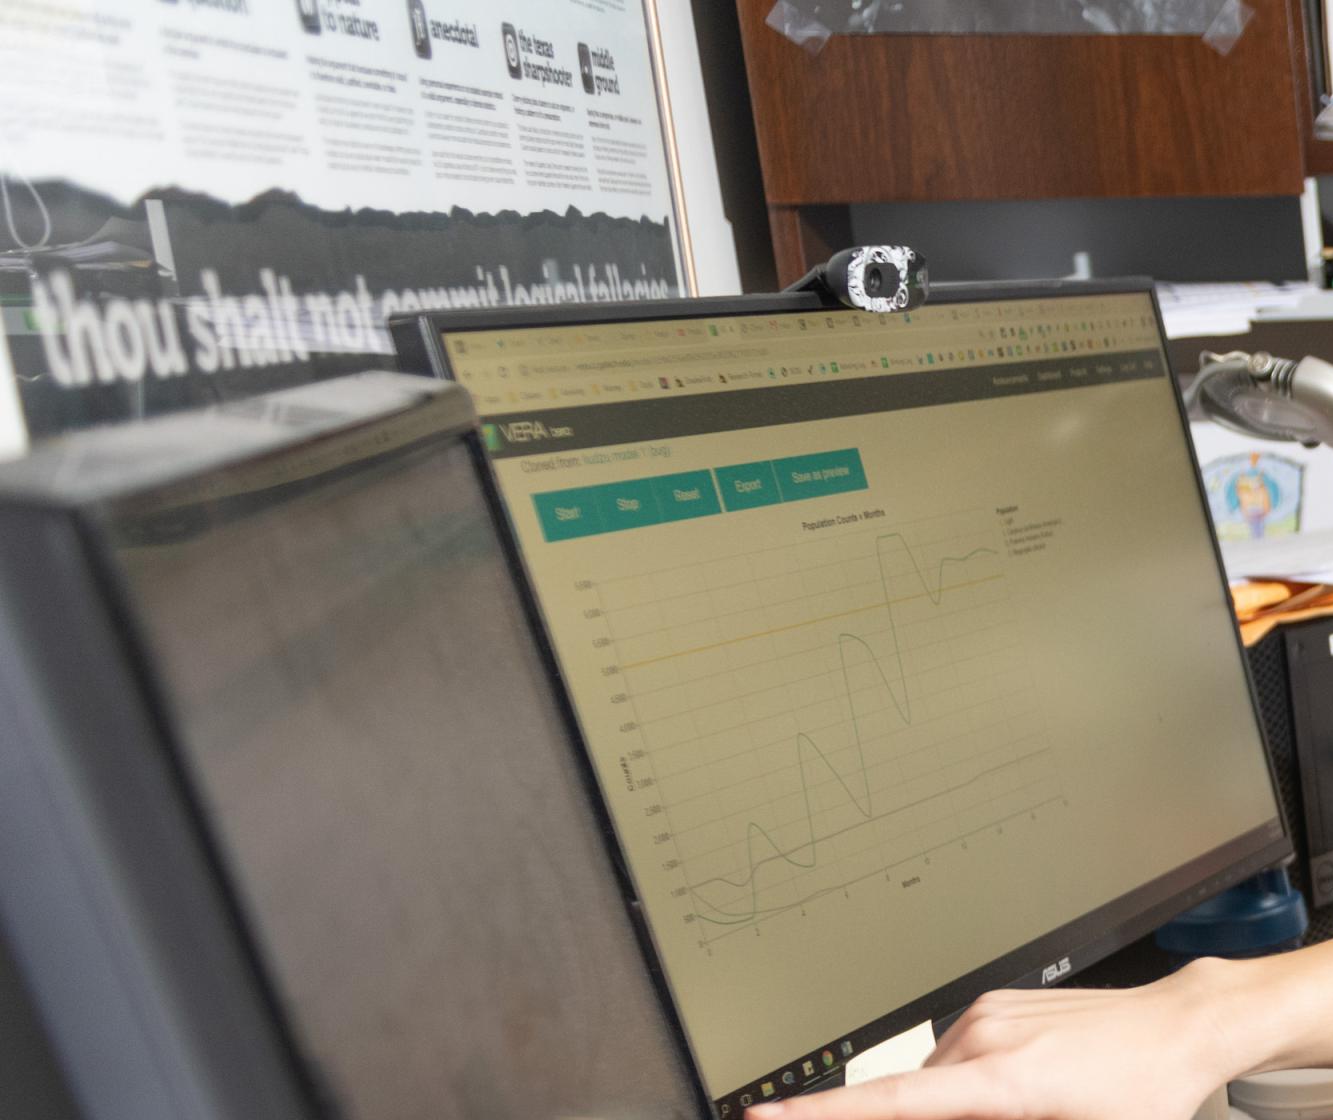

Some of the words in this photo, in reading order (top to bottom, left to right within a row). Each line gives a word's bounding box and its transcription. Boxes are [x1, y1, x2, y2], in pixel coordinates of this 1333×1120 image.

[430, 19, 479, 49] anecdotal
[592, 48, 615, 71] middle
[594, 74, 620, 96] ground
[31, 267, 189, 389] thou
[186, 267, 309, 374] shalt
[303, 273, 382, 354] not
[802, 515, 836, 531] Population
[863, 509, 886, 521] Months
[1042, 957, 1072, 985] ASUS
